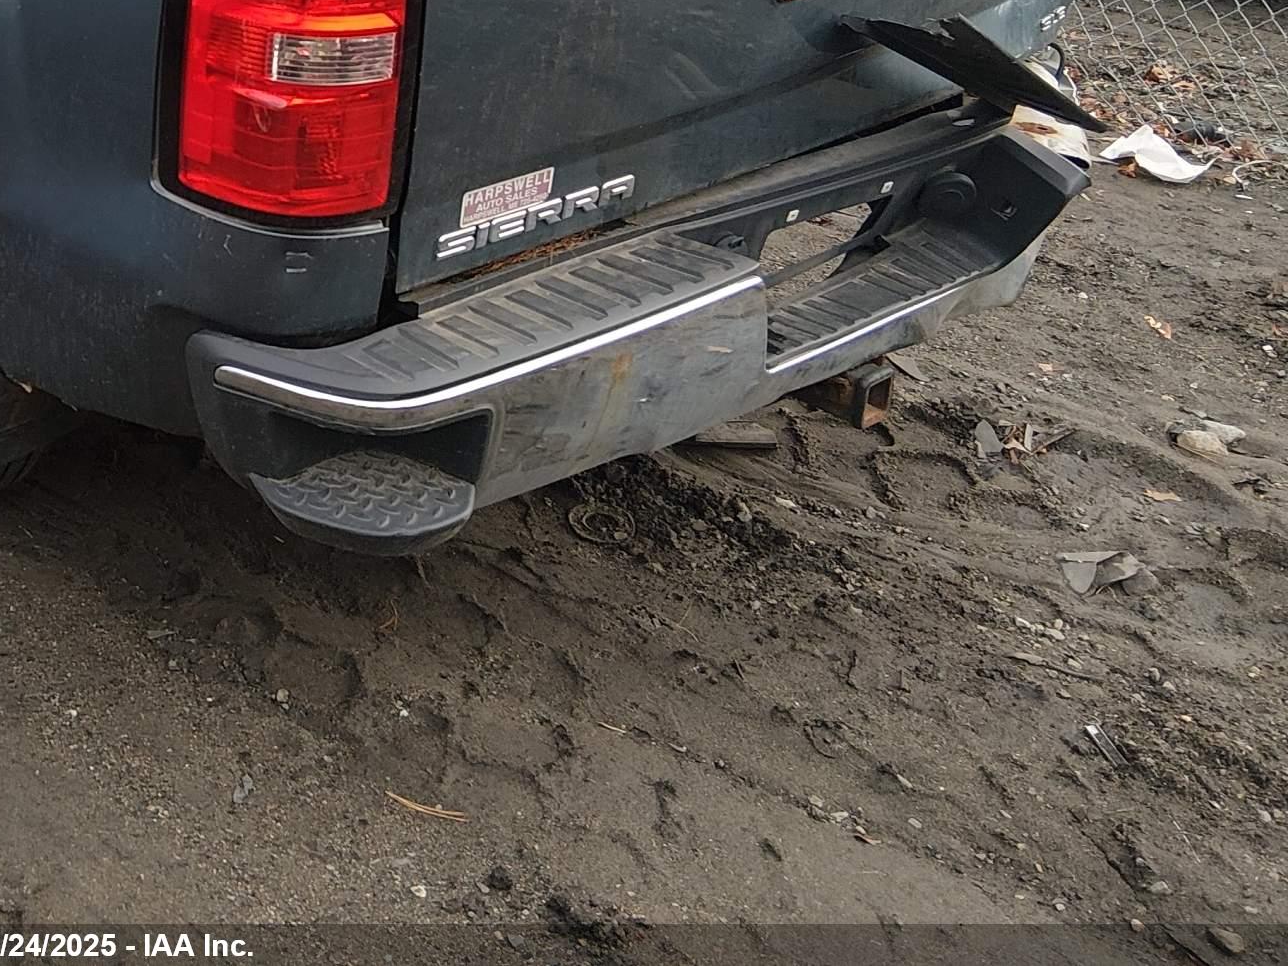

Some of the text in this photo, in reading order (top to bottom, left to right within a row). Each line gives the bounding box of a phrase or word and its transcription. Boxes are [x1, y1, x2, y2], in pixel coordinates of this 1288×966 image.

[464, 170, 551, 208] HARPSWELL
[475, 187, 538, 213] AUTO SALES
[436, 174, 635, 261] SIERRA
